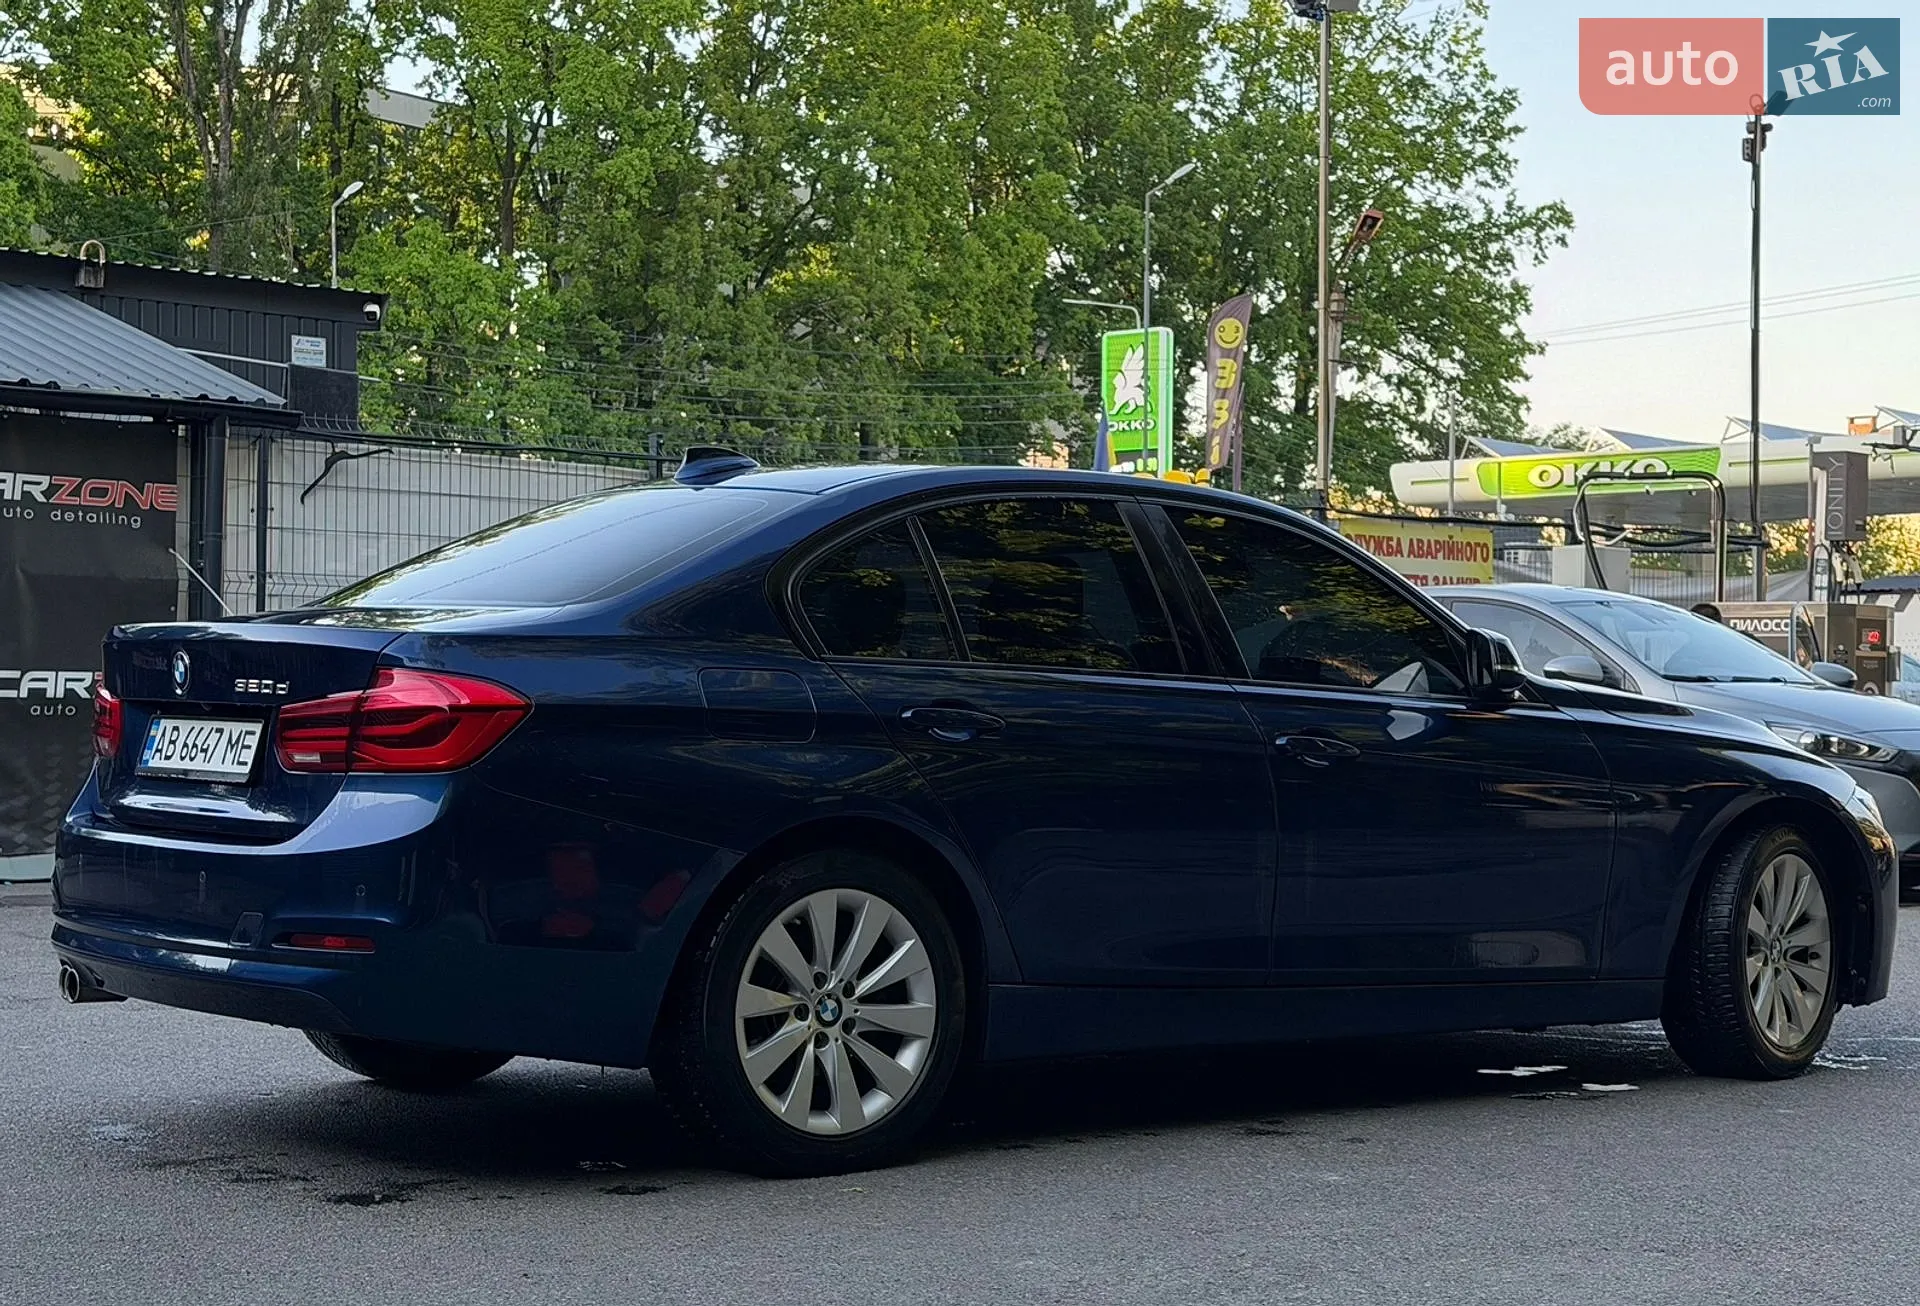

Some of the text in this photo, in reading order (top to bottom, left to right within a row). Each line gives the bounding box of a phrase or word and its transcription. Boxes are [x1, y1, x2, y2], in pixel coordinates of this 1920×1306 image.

[1827, 456, 1844, 535] IONITY
[50, 509, 143, 529] detailing
[1407, 534, 1490, 563] АВАРІЙНОГО
[1730, 619, 1800, 632] ПИЛОСО
[0, 671, 103, 699] CAR
[30, 703, 76, 716] auto
[151, 725, 257, 766] AB 6647 ME
